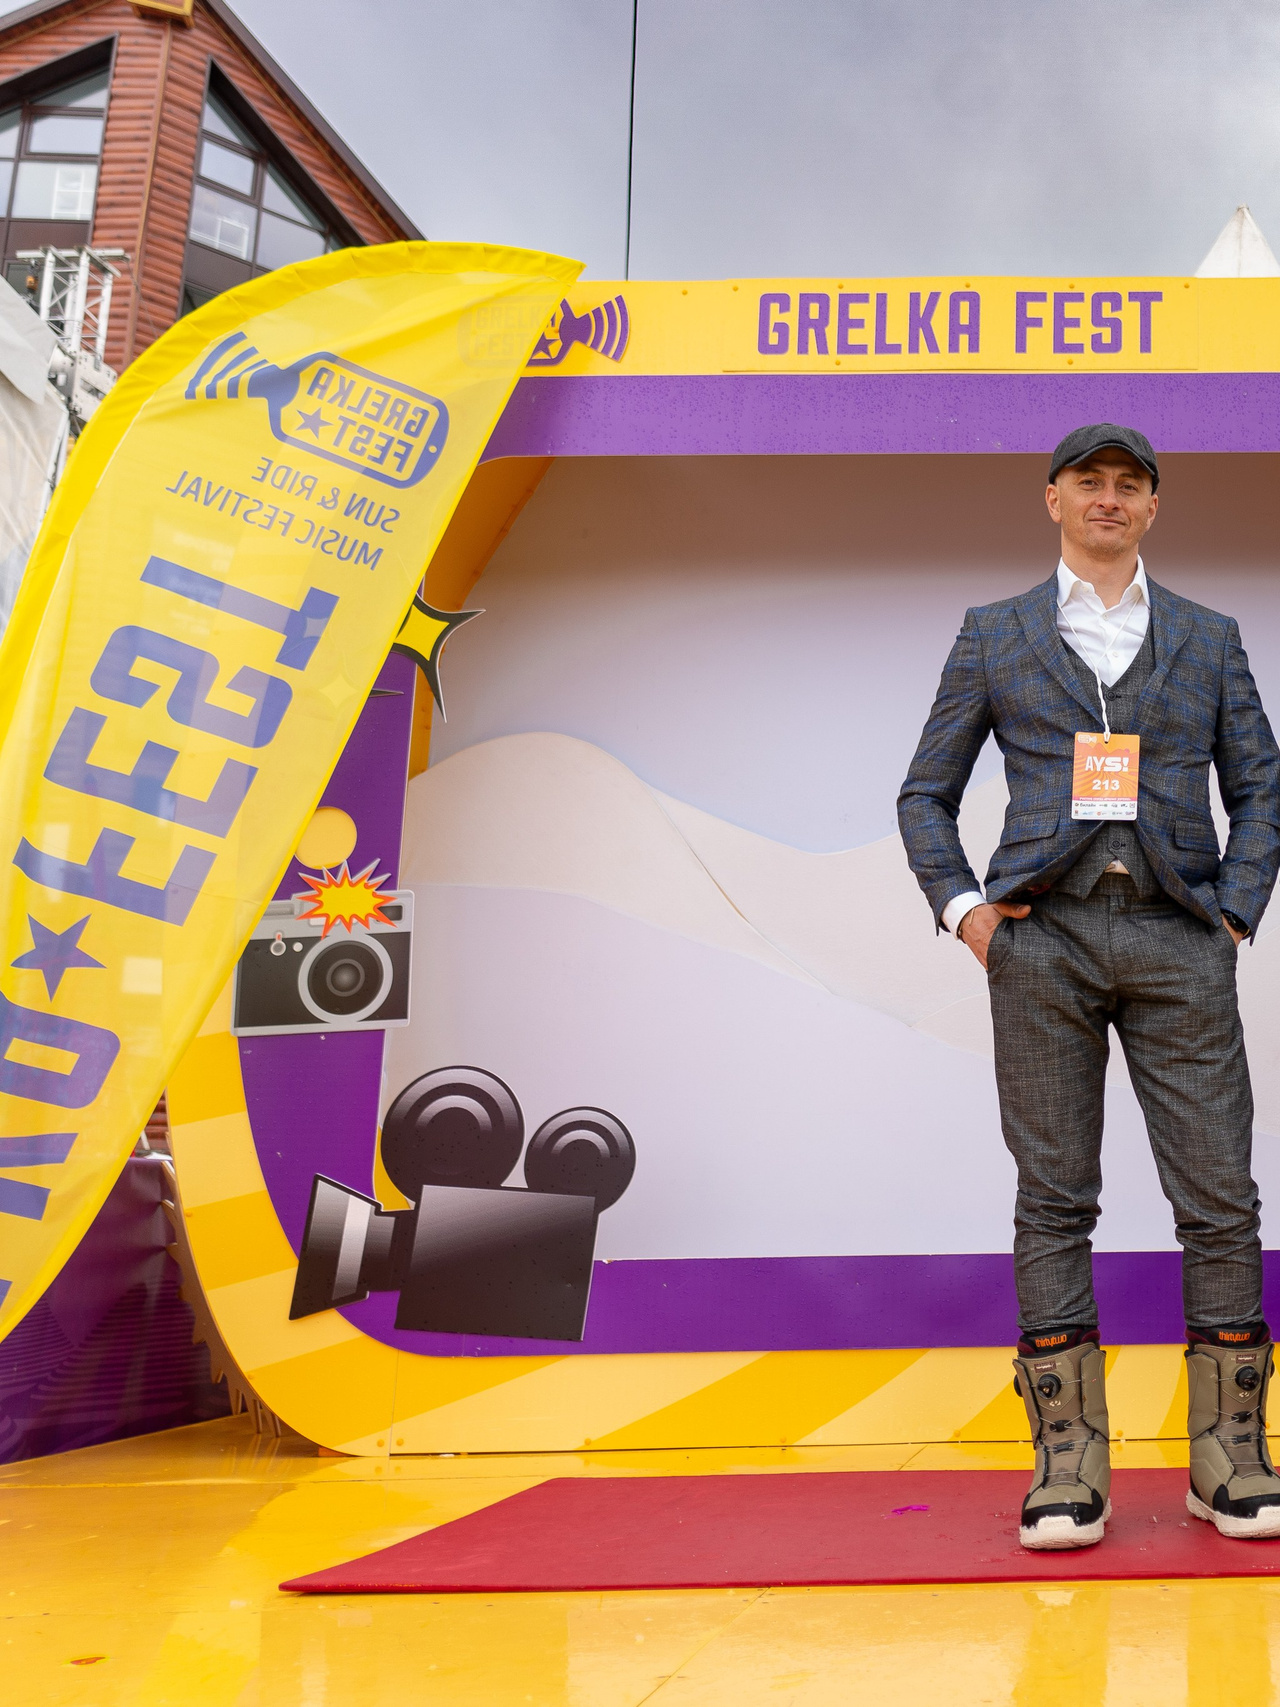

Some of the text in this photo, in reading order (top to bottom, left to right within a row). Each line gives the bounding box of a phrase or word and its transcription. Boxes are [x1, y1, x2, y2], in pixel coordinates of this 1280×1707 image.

[757, 290, 1164, 355] GRELKA FEST
[1084, 756, 1129, 772] AYS!
[1092, 779, 1120, 791] 213
